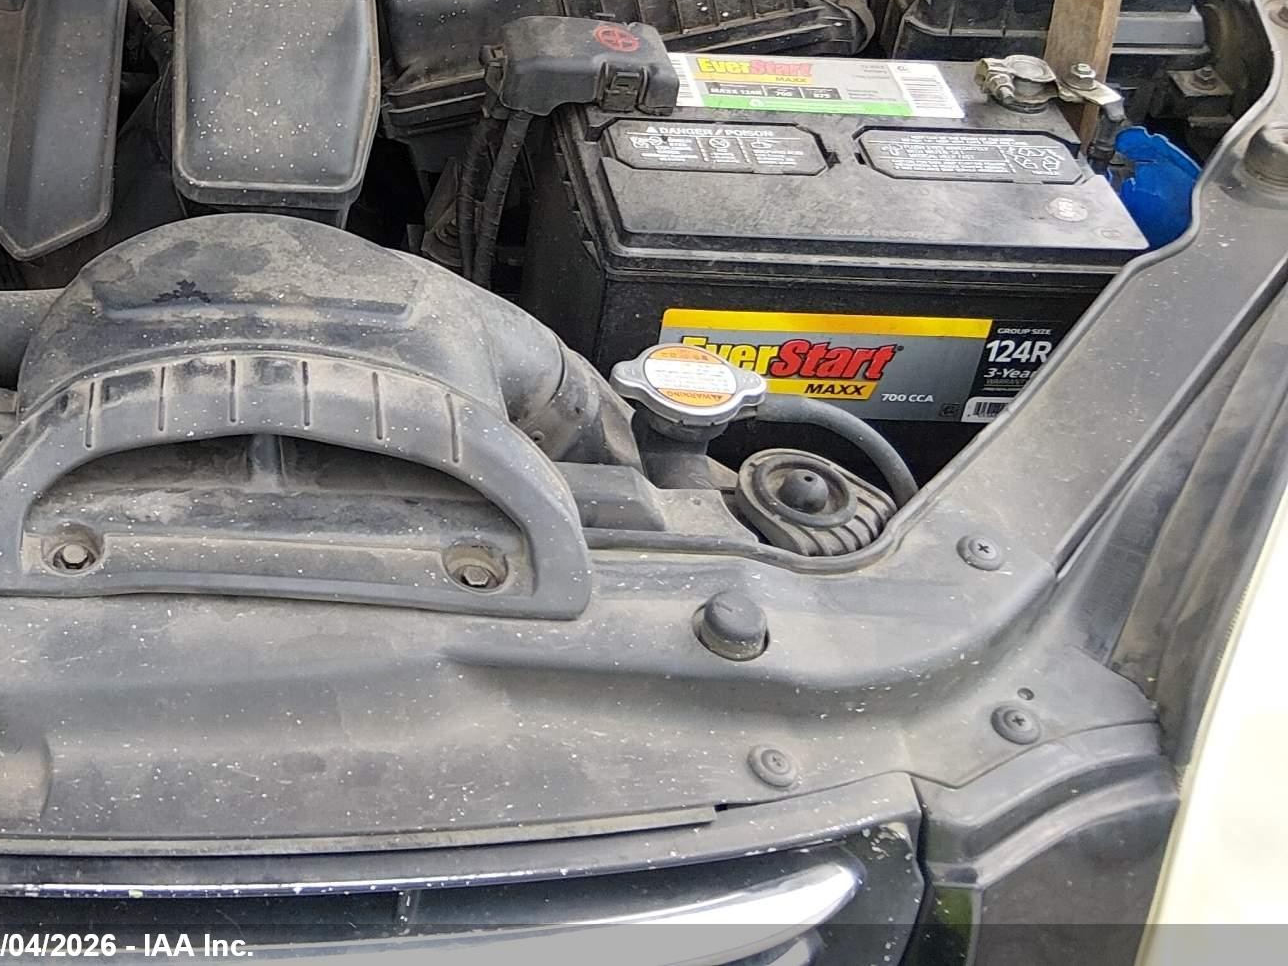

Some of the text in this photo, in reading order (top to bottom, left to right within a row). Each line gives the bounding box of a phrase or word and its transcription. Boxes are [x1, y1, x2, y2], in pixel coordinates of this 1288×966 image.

[659, 127, 713, 135] DANGER
[725, 128, 773, 137] POISON
[986, 340, 1052, 363] 124R
[804, 383, 868, 396] MAXX
[882, 393, 935, 403] 700 CCA
